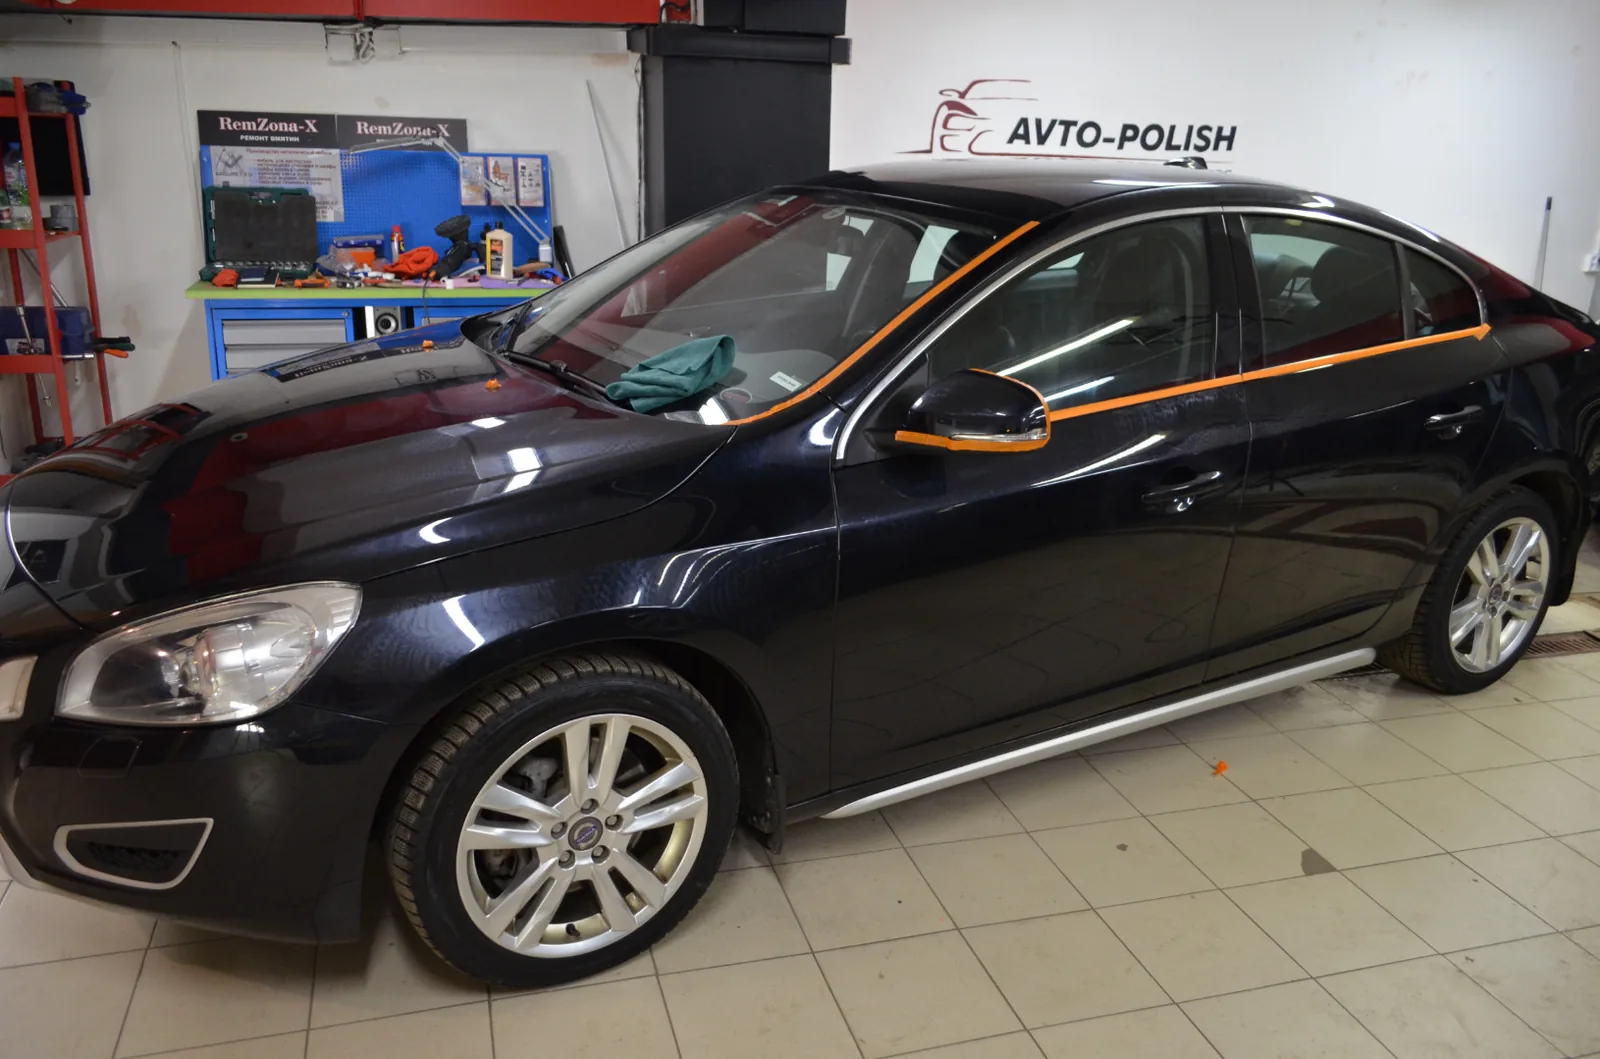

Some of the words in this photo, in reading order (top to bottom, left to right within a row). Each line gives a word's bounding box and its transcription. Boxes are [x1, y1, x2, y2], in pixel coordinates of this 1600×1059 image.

[218, 116, 319, 133] RemZona-X
[356, 121, 450, 137] RemZona-X
[1006, 117, 1237, 151] AVTO-POLISH
